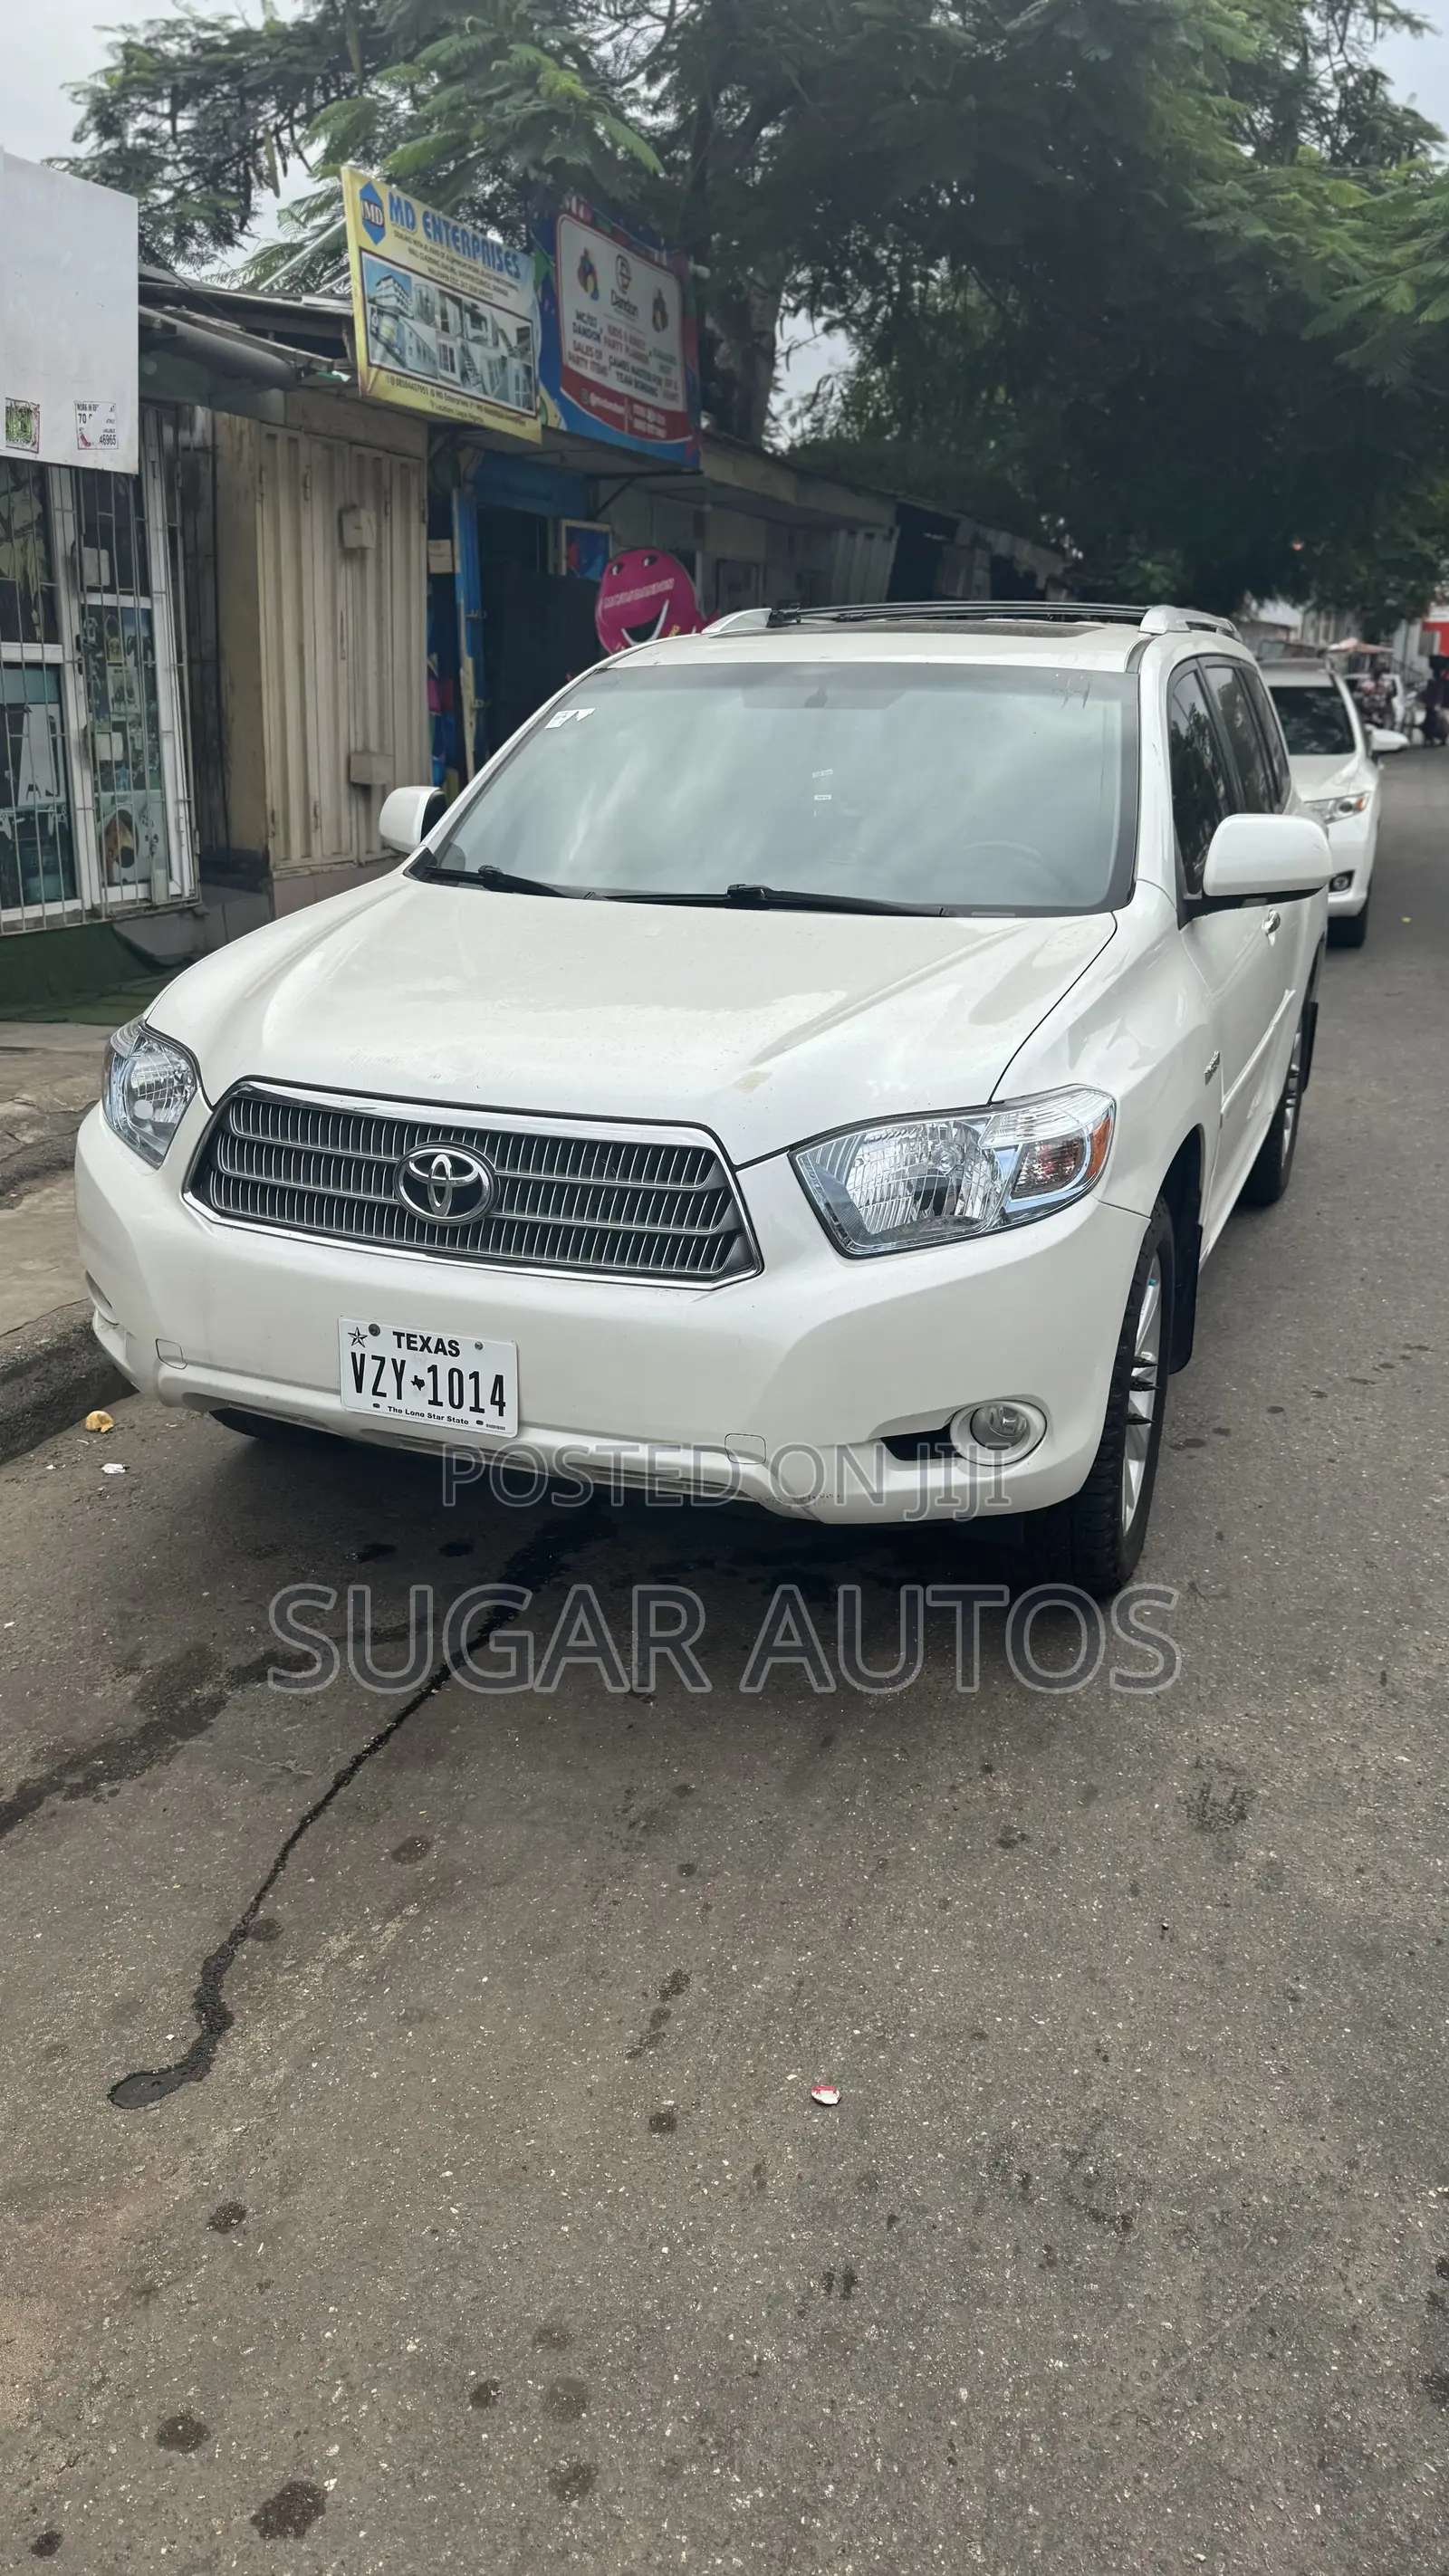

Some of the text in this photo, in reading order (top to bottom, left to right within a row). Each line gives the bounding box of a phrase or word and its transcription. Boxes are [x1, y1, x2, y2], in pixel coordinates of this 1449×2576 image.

[360, 200, 385, 225] MD
[389, 191, 522, 281] MD ENTERPRISES
[610, 288, 639, 319] Dandon
[392, 1331, 460, 1357] TEXAS
[427, 1364, 506, 1417] 1014
[388, 1405, 469, 1425] The Lone Star State
